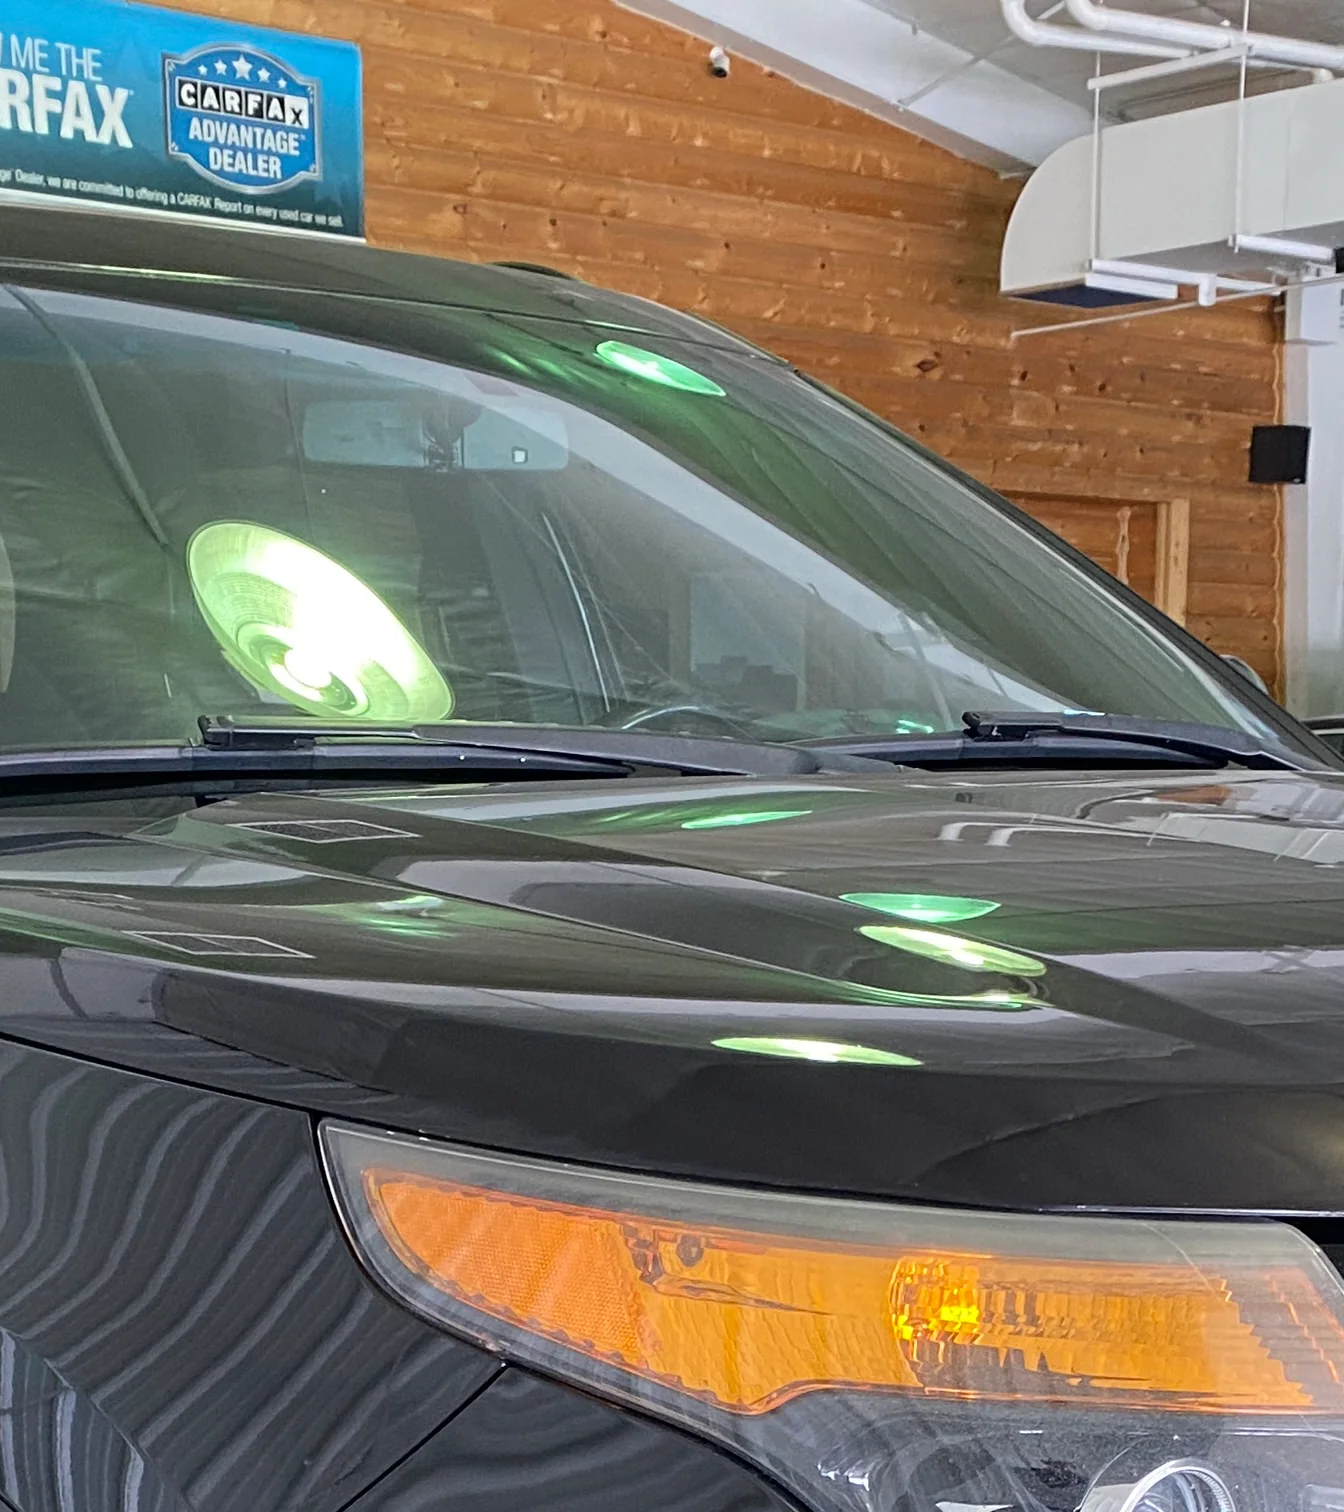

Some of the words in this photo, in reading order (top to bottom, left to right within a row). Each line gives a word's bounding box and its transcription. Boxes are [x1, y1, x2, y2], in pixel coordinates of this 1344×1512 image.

[9, 33, 50, 73] ME
[54, 41, 103, 82] THE
[180, 82, 303, 127] CARFAX
[188, 116, 301, 156] ADVANTAGE
[208, 146, 282, 180] DEALER
[47, 176, 61, 189] we
[62, 176, 77, 190] are
[78, 178, 124, 197] committed
[125, 186, 134, 200] to
[135, 187, 168, 205] offering
[213, 196, 242, 214] Report
[243, 202, 254, 214] on
[255, 204, 278, 220] every
[278, 207, 299, 222] used
[300, 210, 313, 223] car
[313, 212, 327, 226] we
